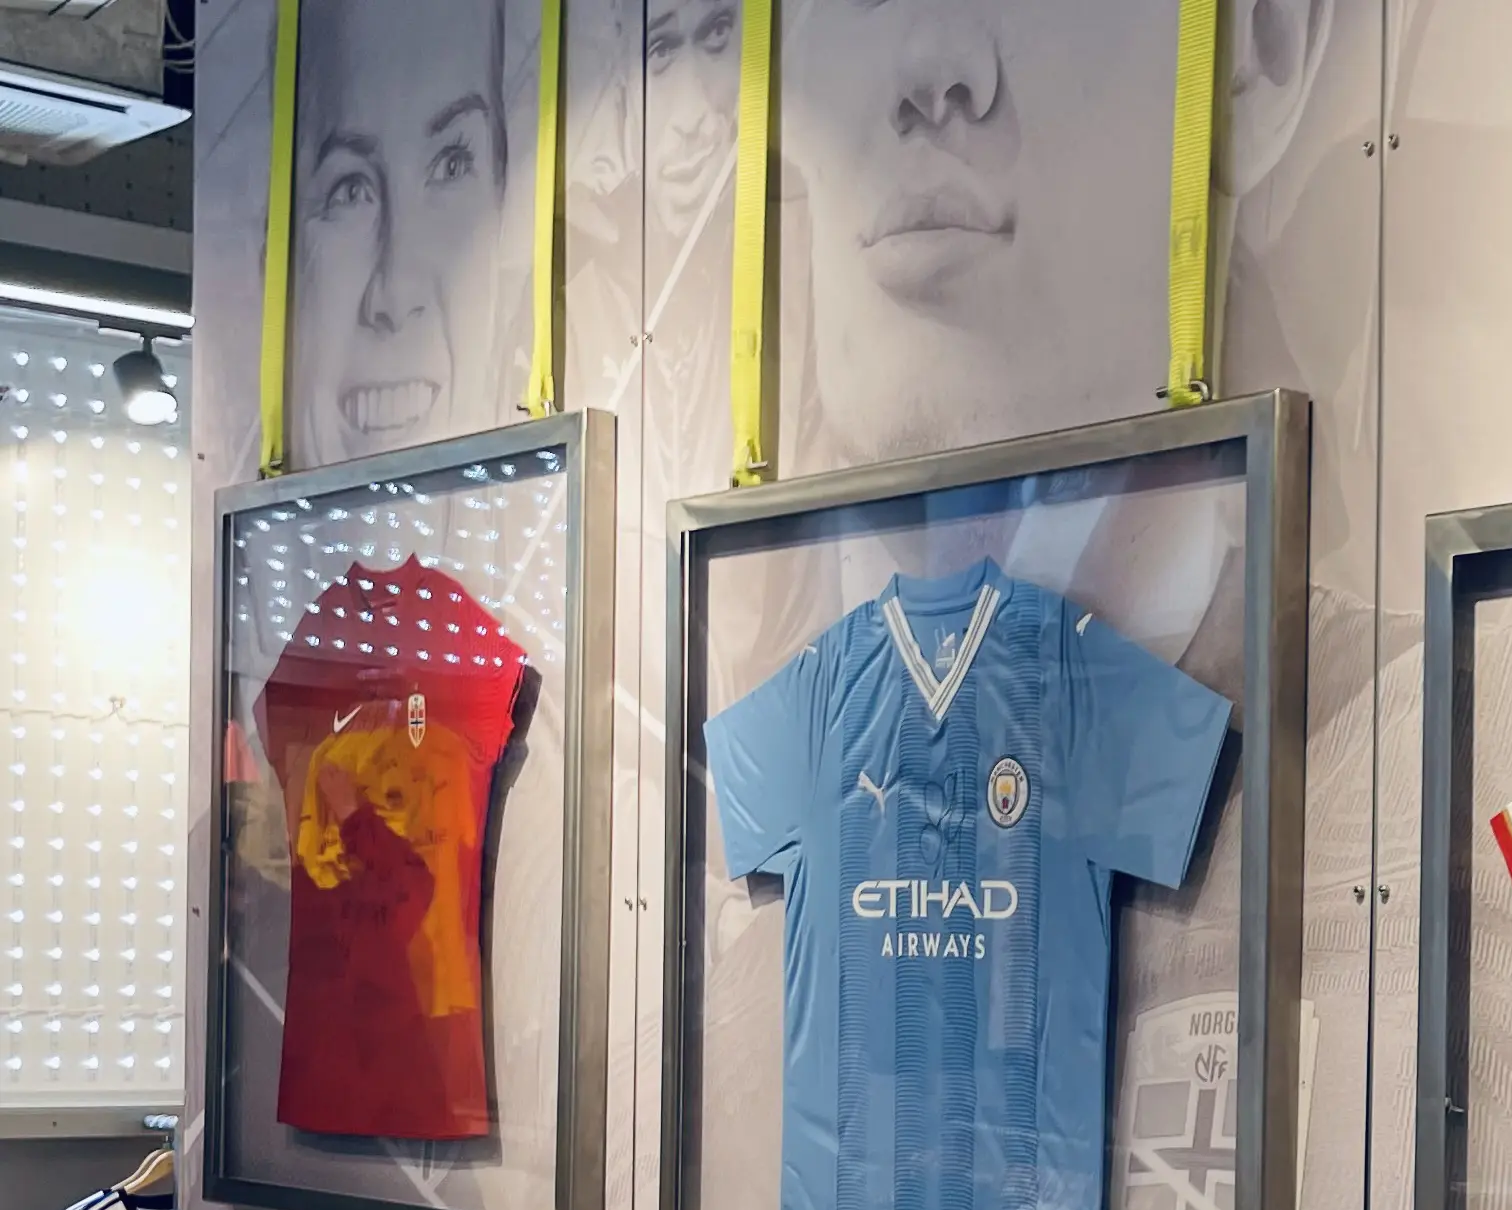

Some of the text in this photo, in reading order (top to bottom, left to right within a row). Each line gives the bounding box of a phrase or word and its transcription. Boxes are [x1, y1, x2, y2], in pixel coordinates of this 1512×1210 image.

[852, 879, 1018, 919] ETIHAD
[881, 932, 986, 960] AIRWAYS
[1188, 1010, 1239, 1036] NORG
